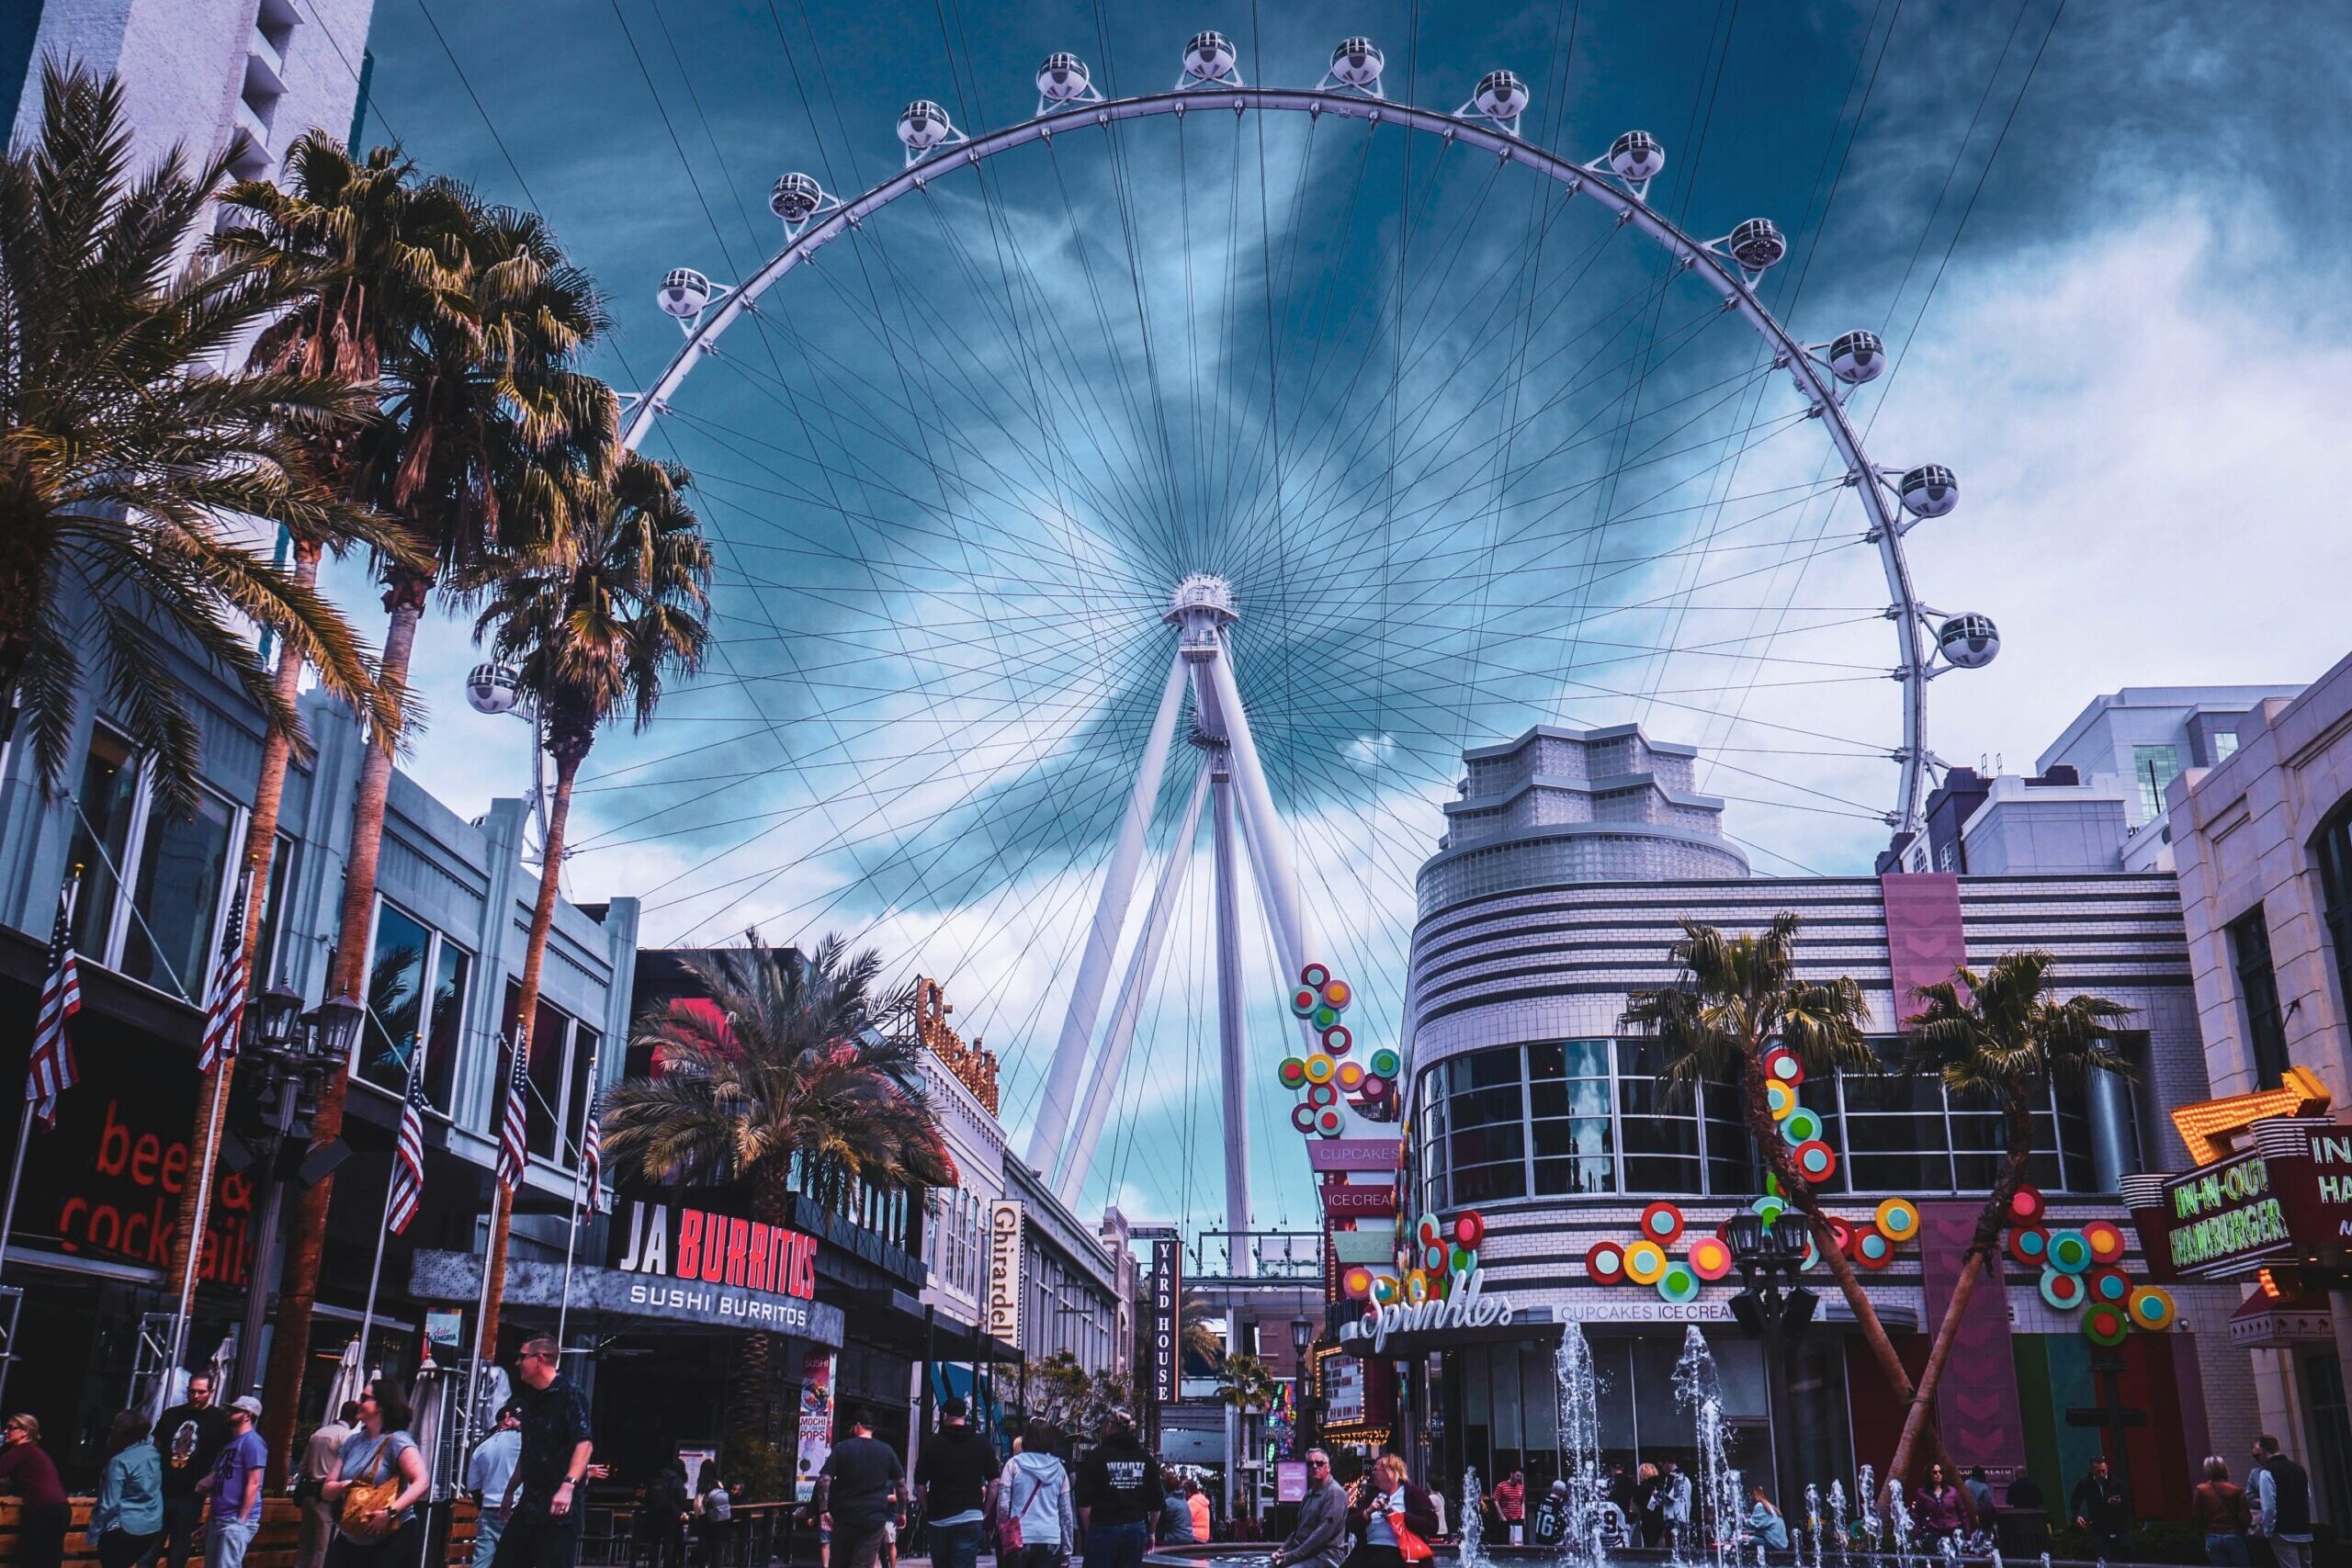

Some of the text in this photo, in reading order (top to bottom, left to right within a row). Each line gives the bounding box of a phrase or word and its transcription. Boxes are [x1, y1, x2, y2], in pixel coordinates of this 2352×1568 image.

[96, 1100, 188, 1193] bee
[1320, 1149, 1399, 1160] CUPCAKES
[1329, 1194, 1392, 1206] ICE CREA
[2175, 1157, 2269, 1221] IN-N-OUT
[59, 1196, 254, 1285] cockail
[619, 1201, 818, 1301] JA BURRITOS
[630, 1285, 807, 1326] SUSHI BURRITOS
[1158, 1243, 1170, 1401] YARD HOUSE
[1361, 1268, 1525, 1354] Sprinkles
[1561, 1305, 1653, 1320] CUPCAKES
[1658, 1305, 1683, 1319] ICE
[804, 1359, 829, 1368] SUSHI
[799, 1430, 826, 1440] POPS
[800, 1417, 826, 1426] MOCHI
